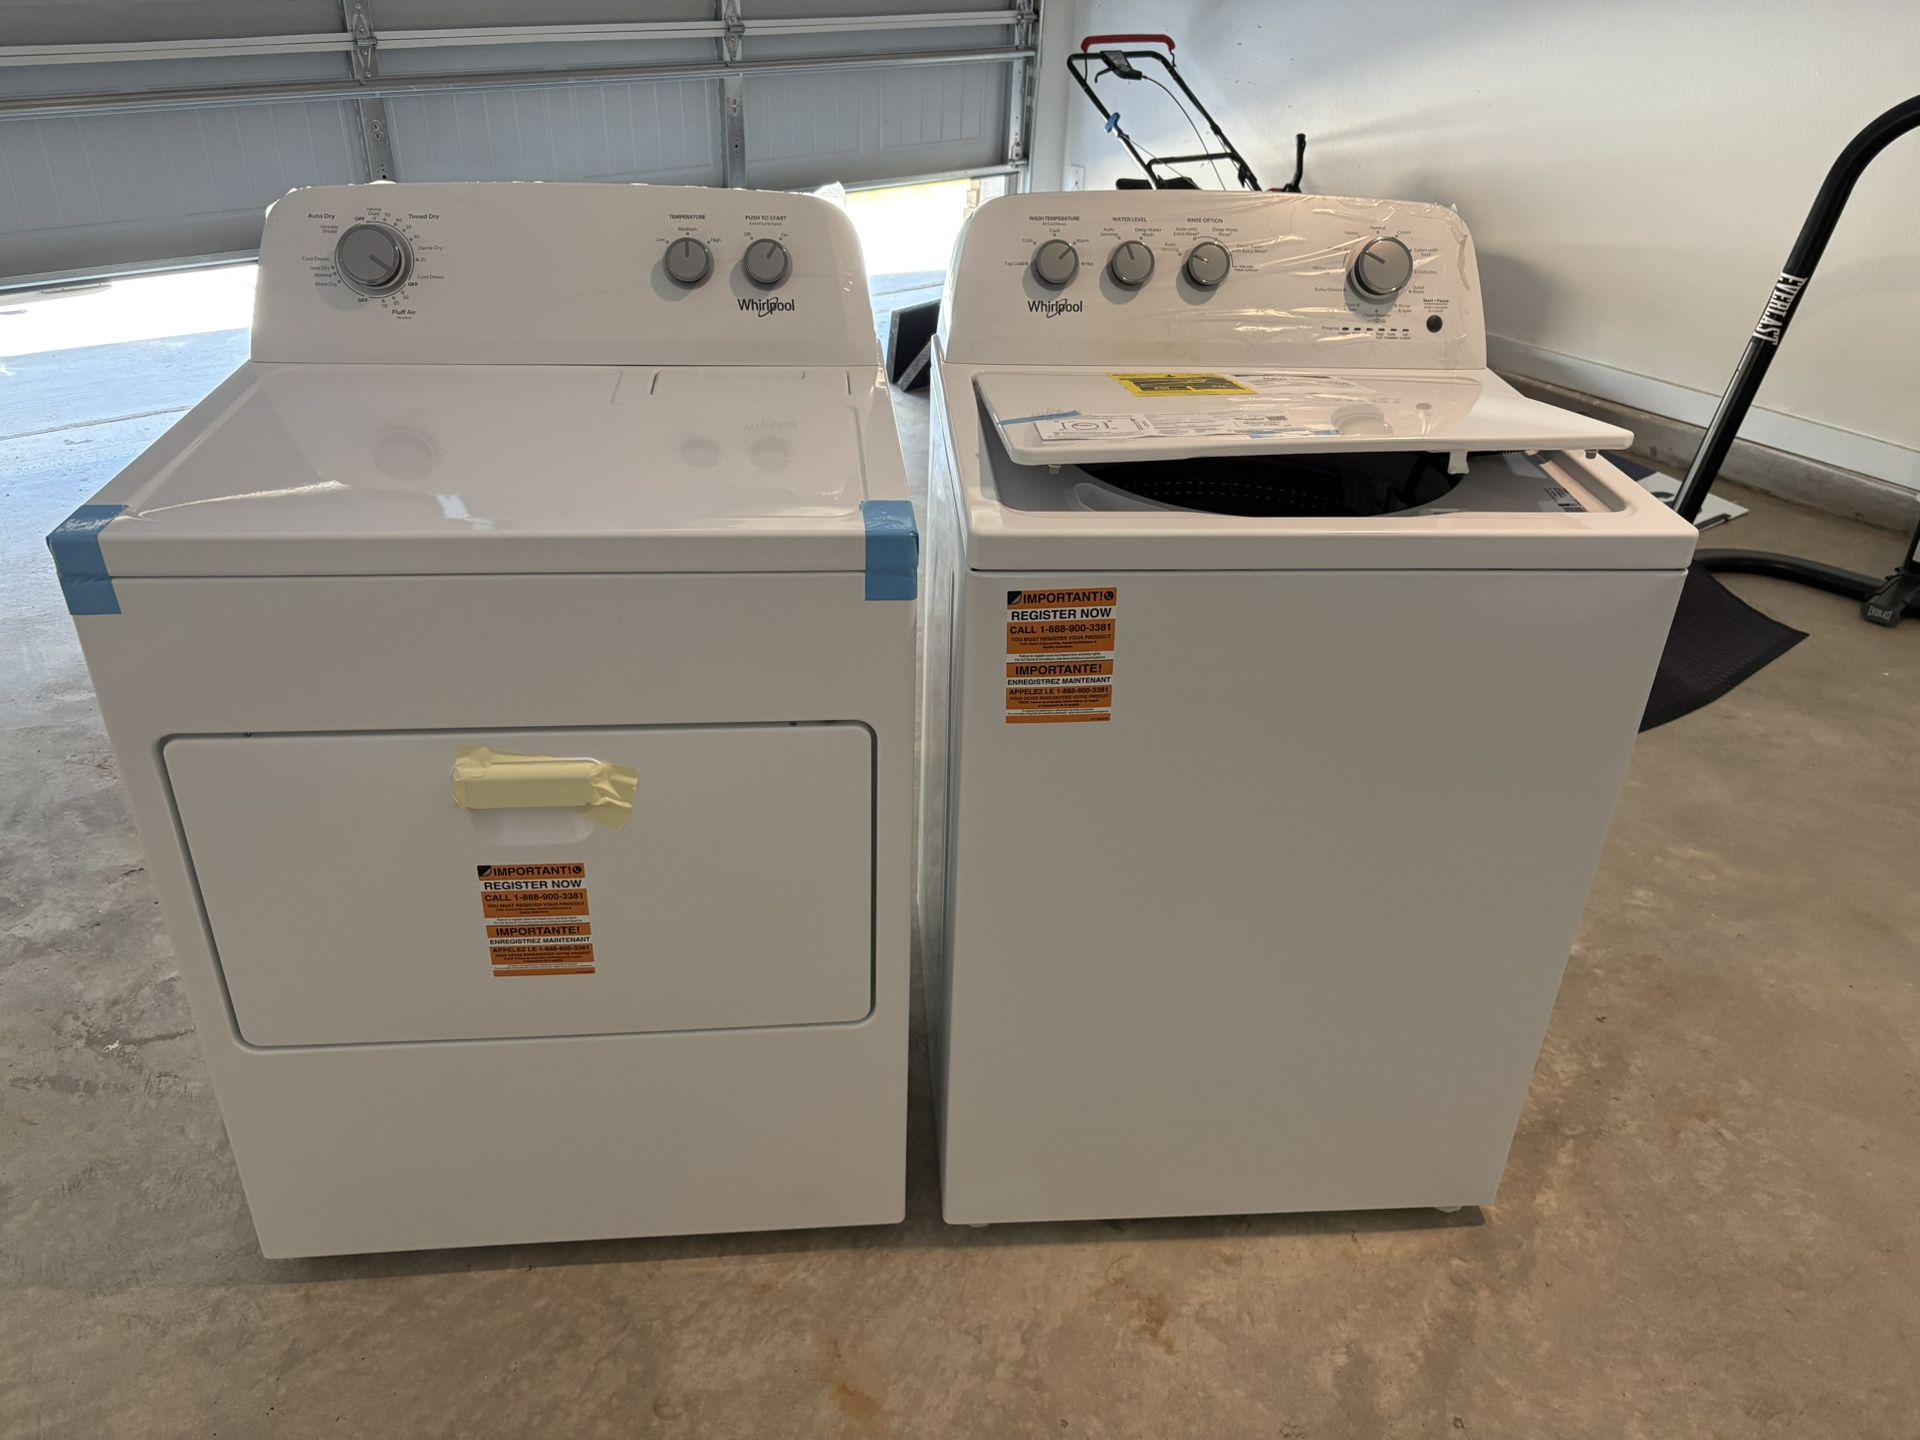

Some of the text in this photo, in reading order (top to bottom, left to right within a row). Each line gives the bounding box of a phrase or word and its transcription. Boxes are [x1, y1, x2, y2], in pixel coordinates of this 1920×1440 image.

[324, 212, 336, 220] Dry
[428, 213, 440, 221] Dry
[738, 297, 796, 318] Whirlpool
[1028, 299, 1083, 318] Whirlpool
[1752, 271, 1808, 346] EVERLAST
[1023, 591, 1103, 604] IMPORTANT!
[1012, 608, 1112, 621] REGISTER NOW
[1010, 624, 1111, 634] CALL 1-888-900-3381
[1016, 664, 1102, 676] IMPORTANTE!
[493, 866, 572, 876] IMPORTANT!
[484, 880, 582, 890] REGISTER NOW
[484, 892, 584, 902] CALL 1-888-900-3381
[496, 926, 580, 936] IMPORTANTE!
